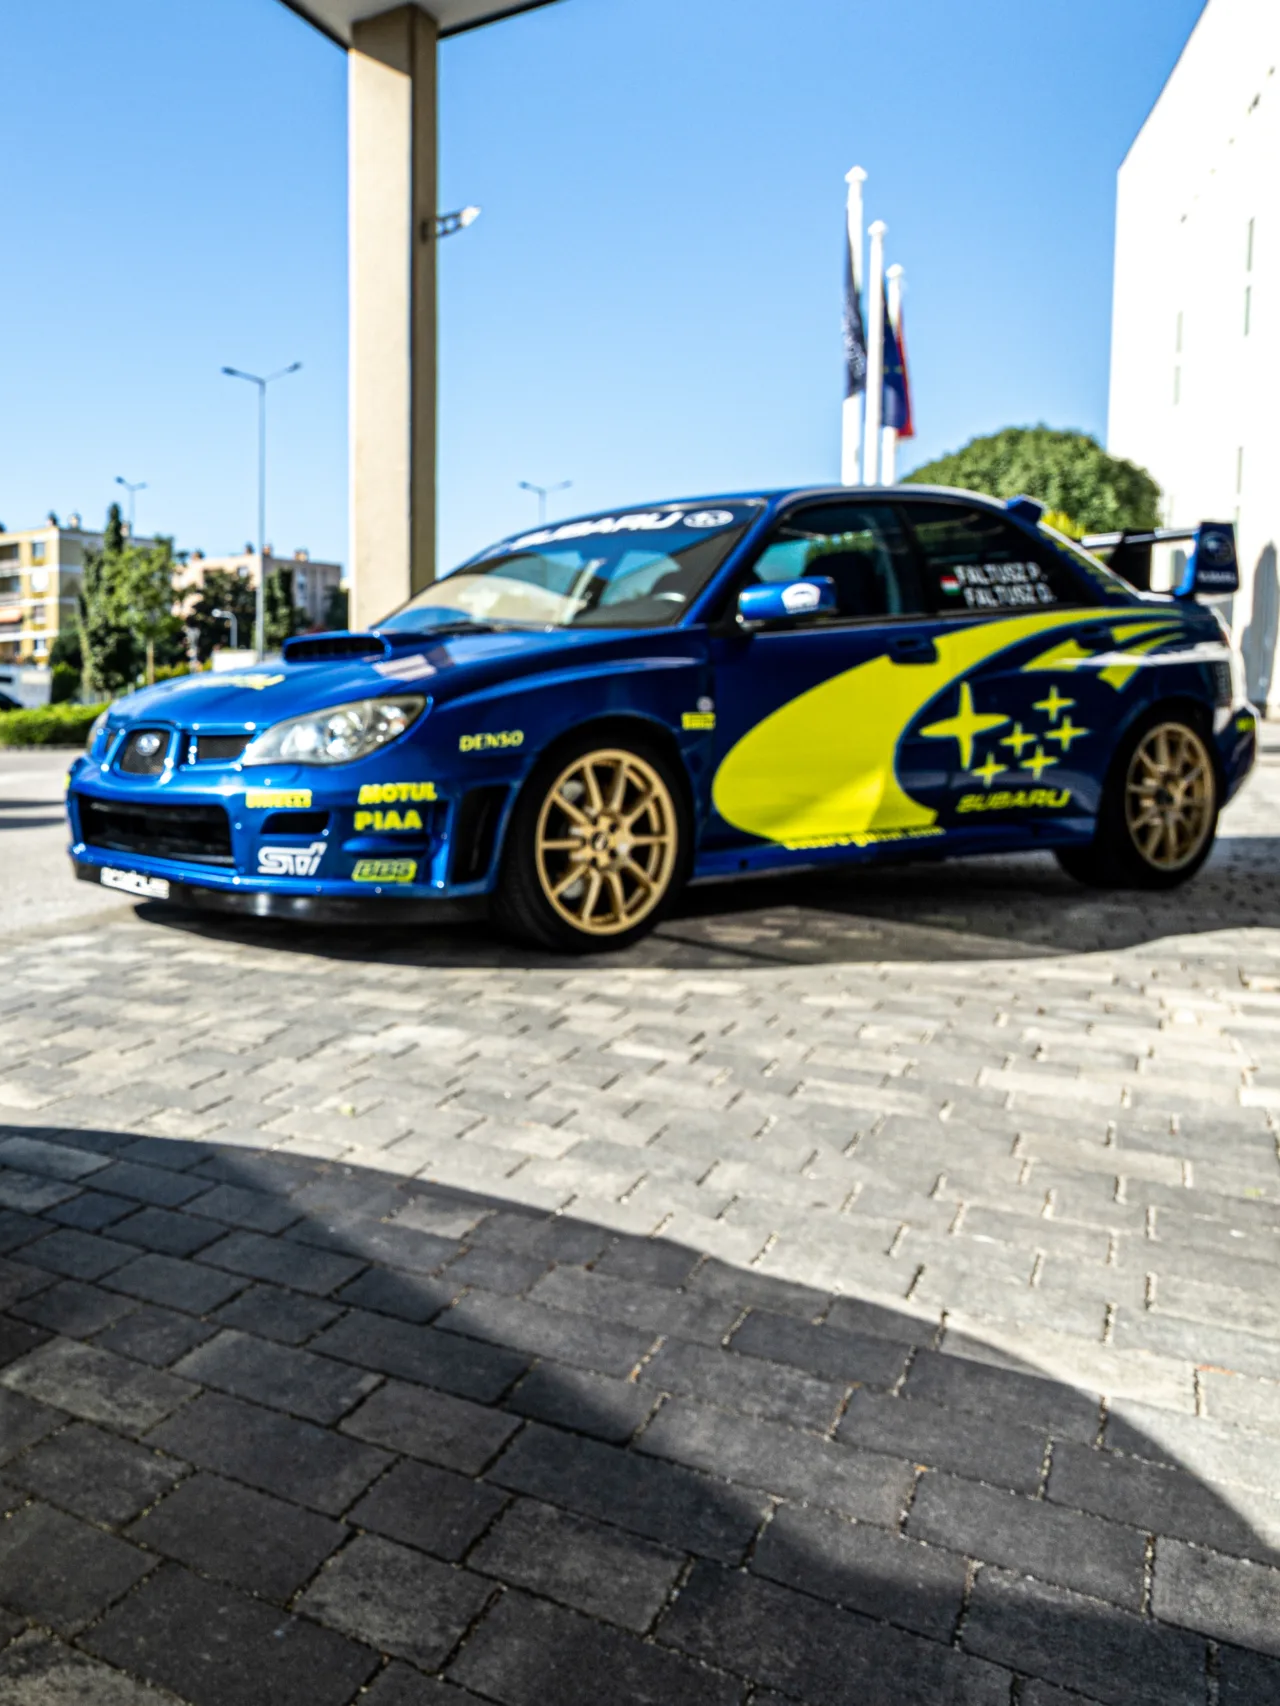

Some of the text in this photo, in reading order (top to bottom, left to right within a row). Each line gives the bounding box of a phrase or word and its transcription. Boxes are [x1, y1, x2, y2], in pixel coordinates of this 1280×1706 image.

[458, 729, 524, 752] DENSO
[357, 782, 438, 805] MOTUL
[956, 788, 1072, 813] SUBARU
[353, 810, 422, 831] PIAA
